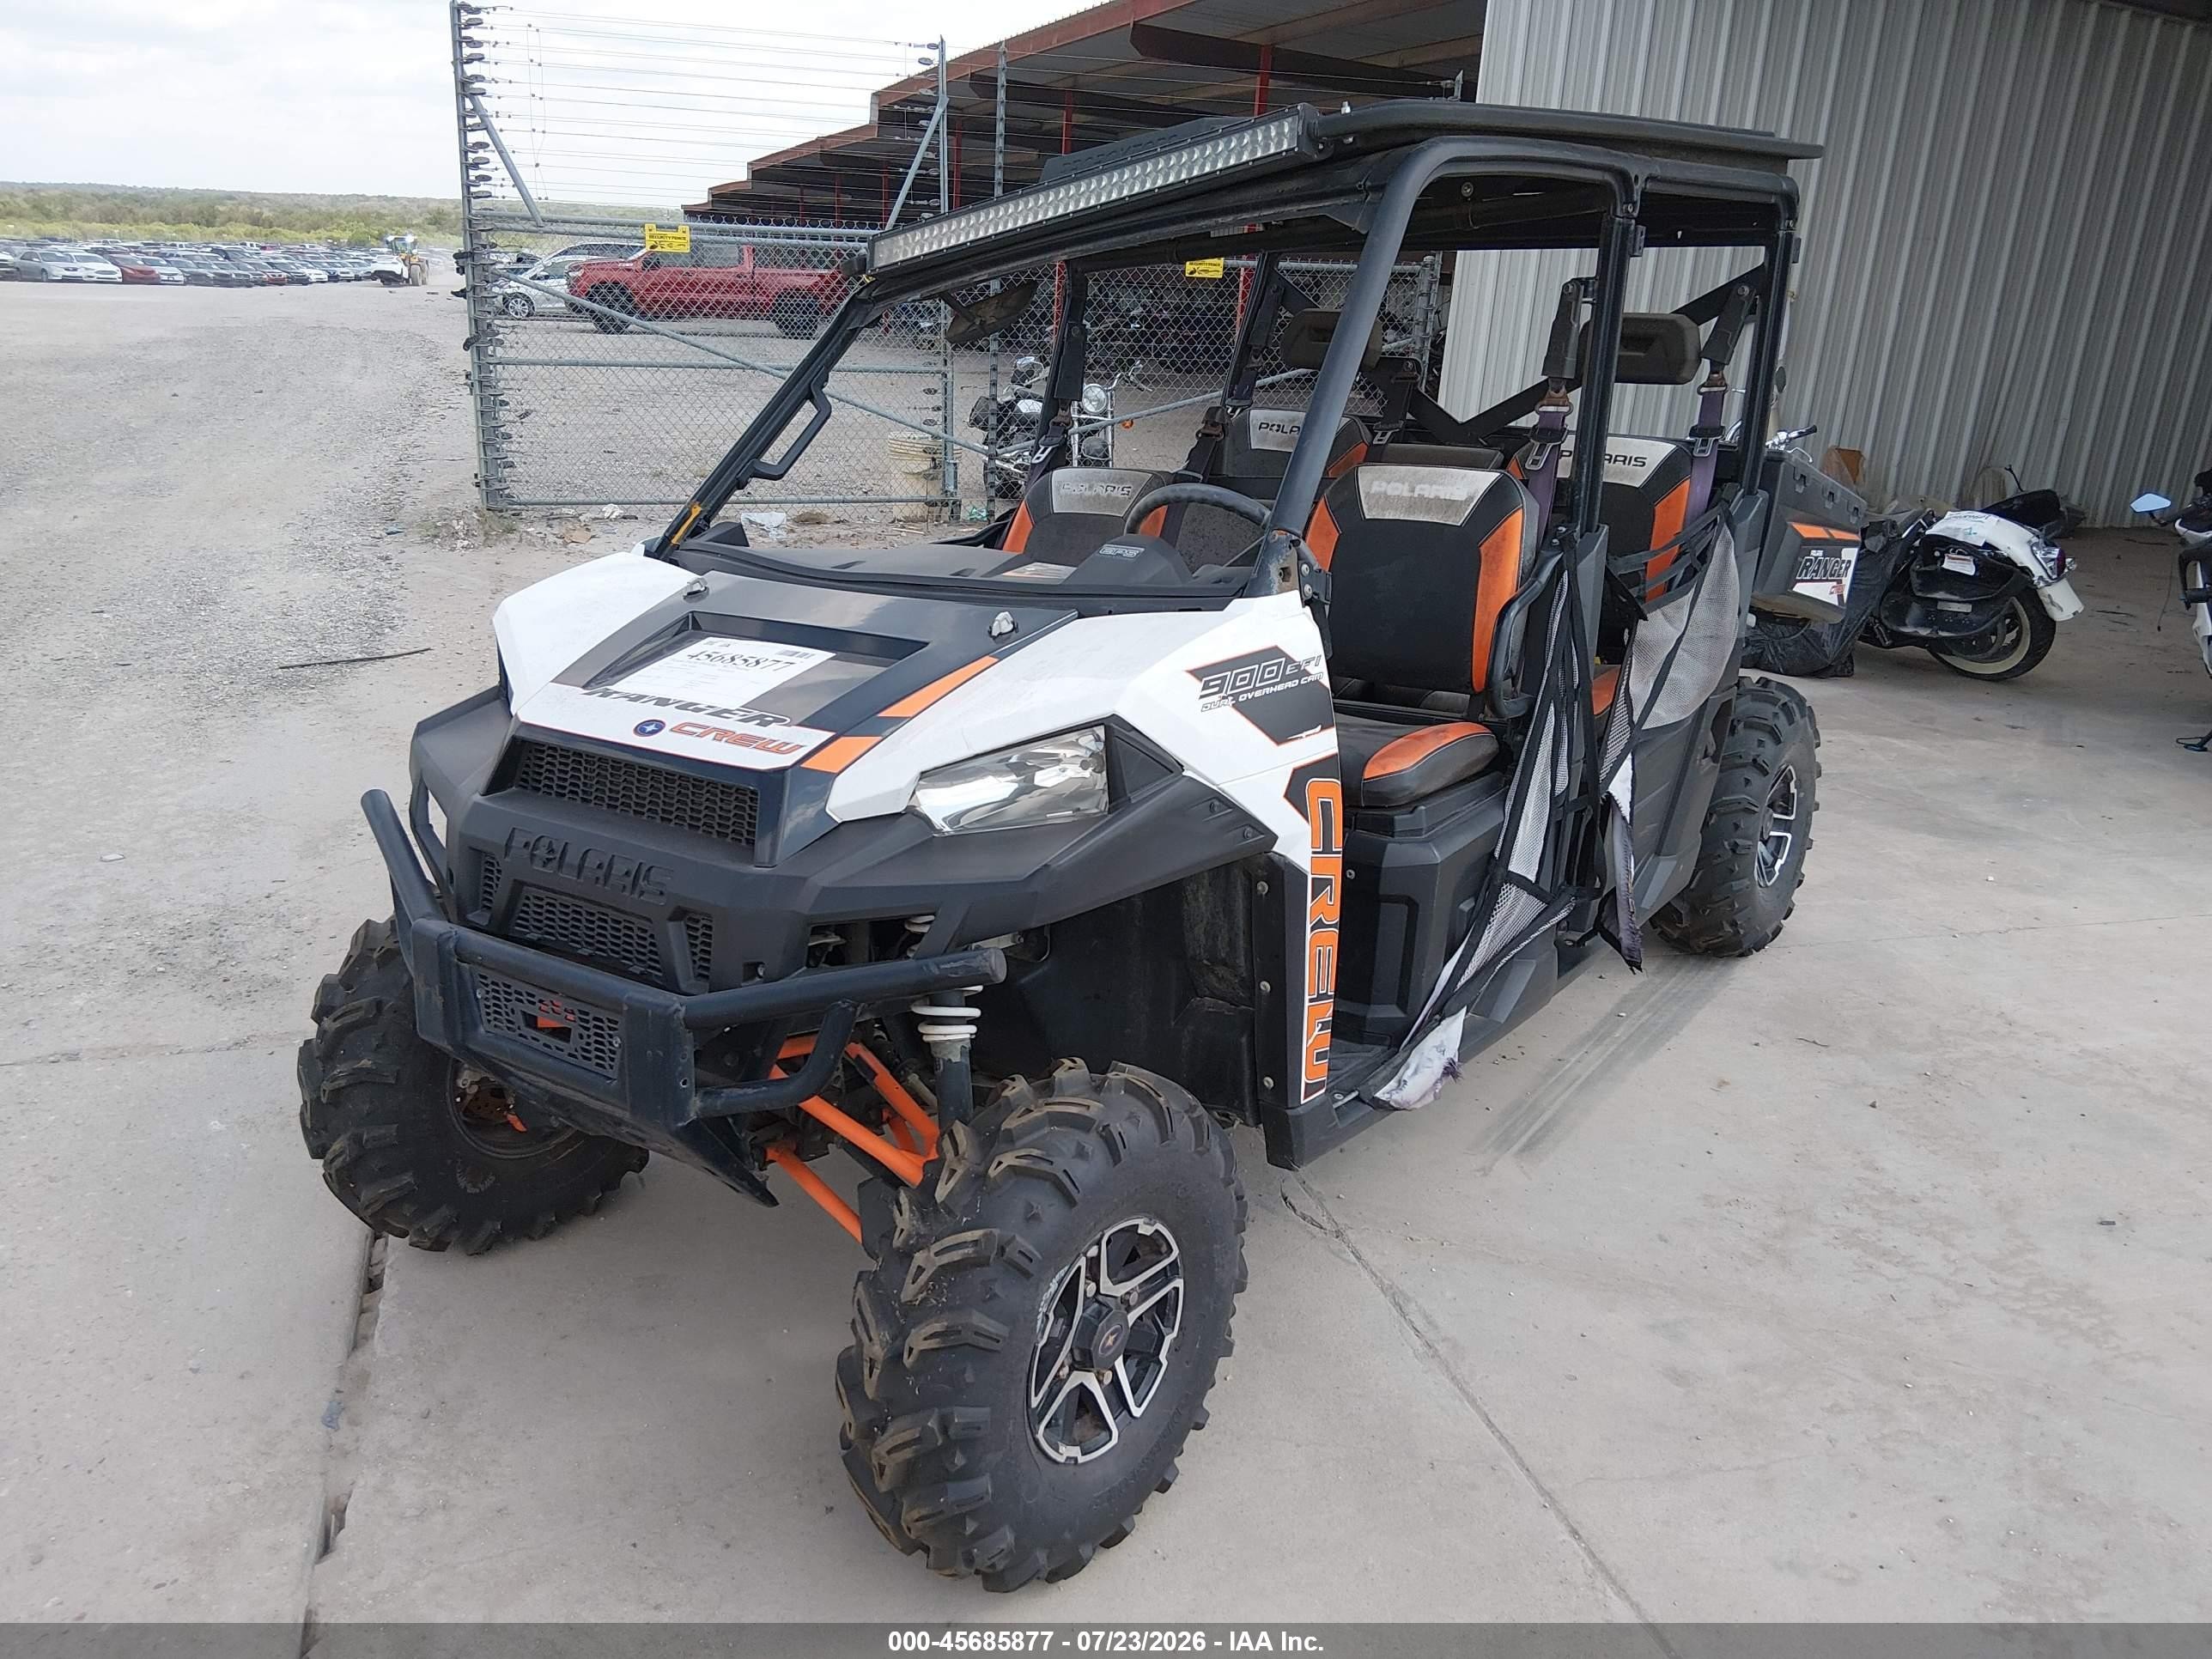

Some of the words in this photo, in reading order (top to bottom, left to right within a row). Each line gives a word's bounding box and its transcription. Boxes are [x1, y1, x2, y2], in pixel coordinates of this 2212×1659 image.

[1258, 422, 1302, 435] POLA
[1559, 449, 1648, 468] PARIS
[1796, 556, 1852, 580] RANGER
[687, 649, 798, 672] 45685877
[1199, 658, 1286, 700] 900
[1285, 654, 1322, 676] EFI
[1238, 677, 1300, 702] OVERHEAD
[1300, 672, 1324, 685] CAM
[581, 687, 793, 729] RANGER
[670, 721, 807, 756] CREW
[503, 826, 675, 907] POLARIS
[1306, 778, 1343, 1084] CREW
